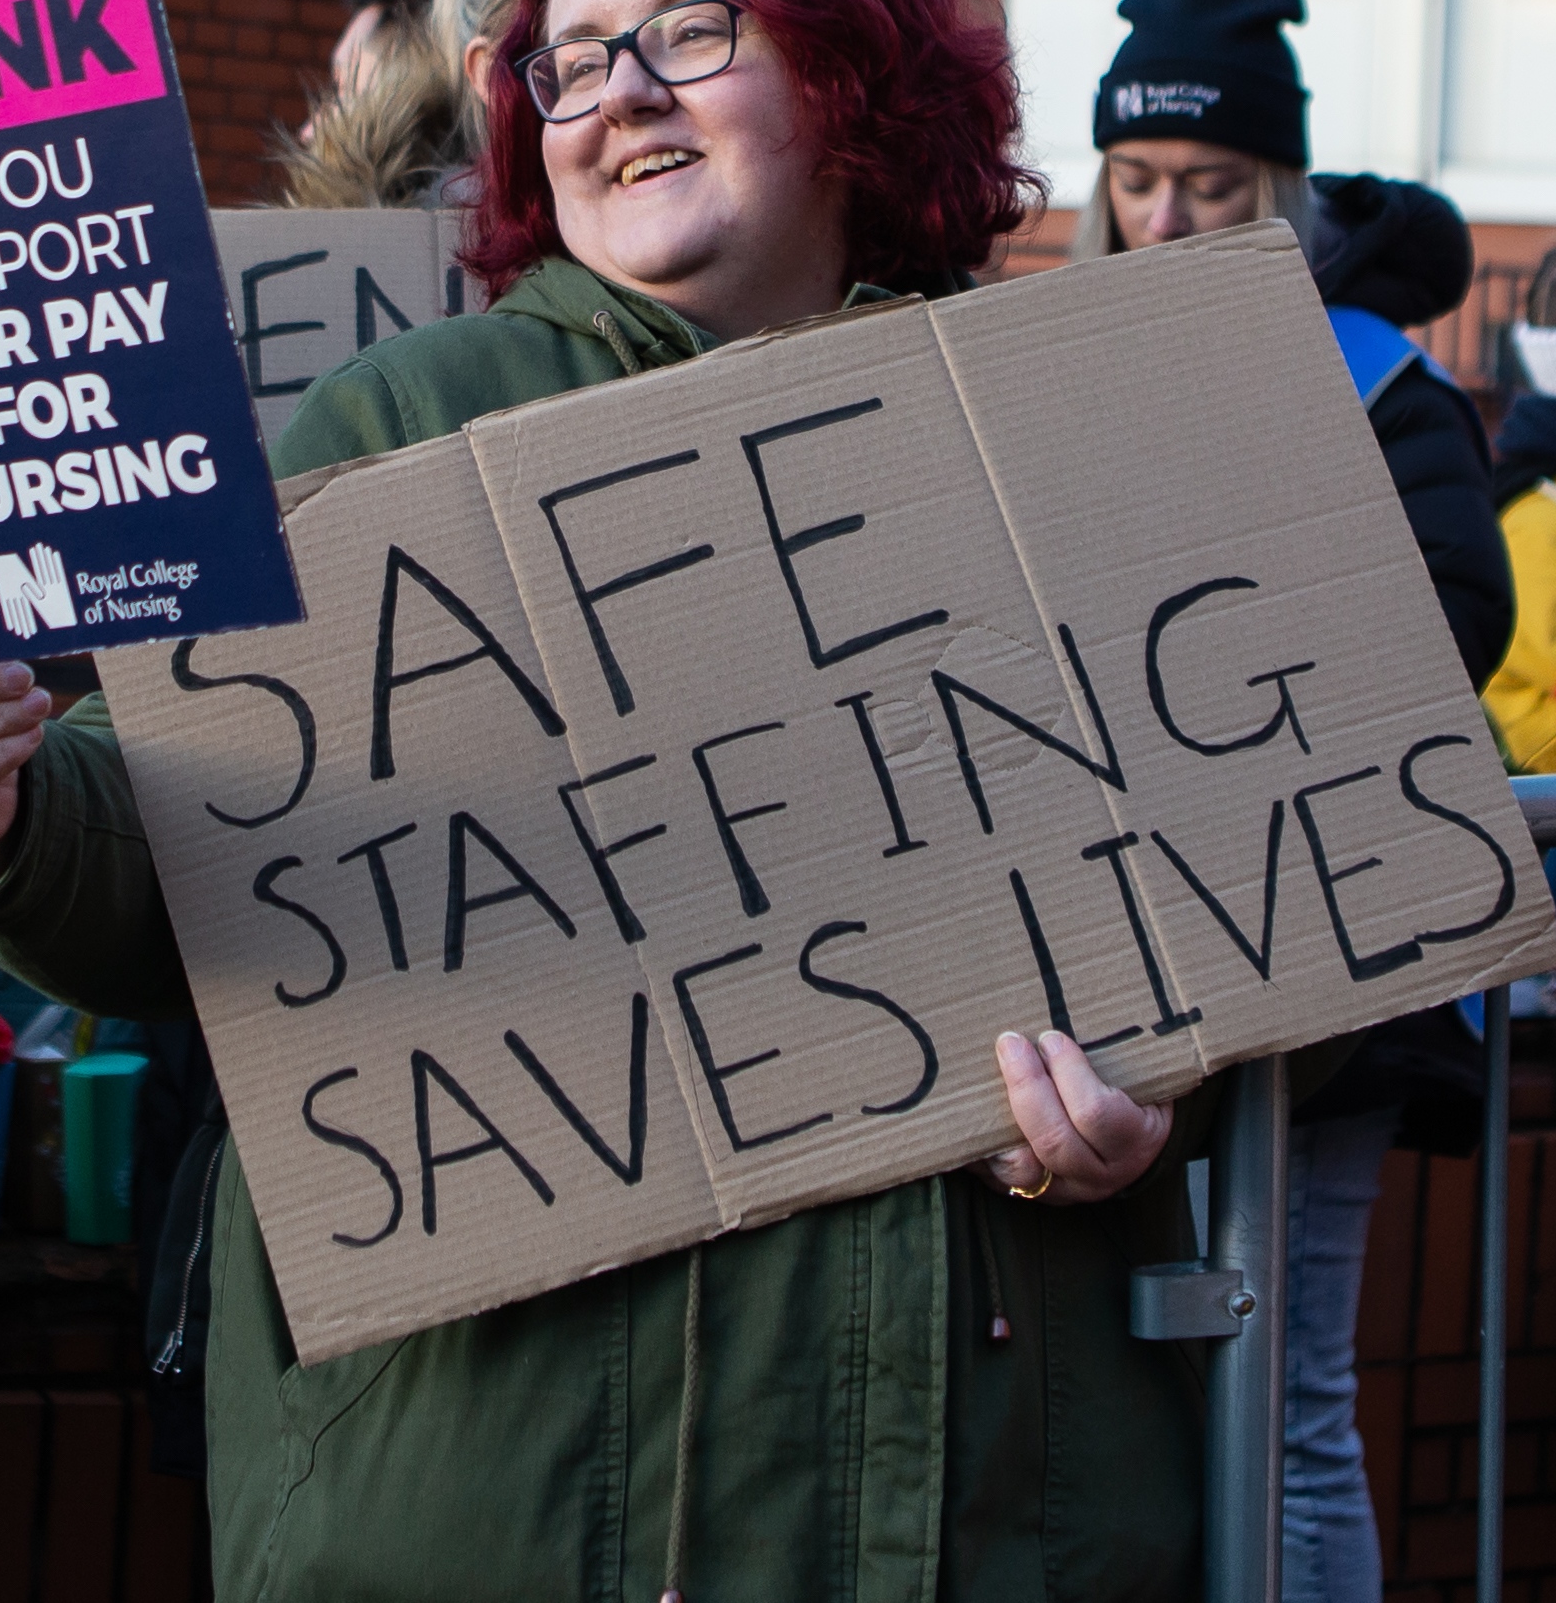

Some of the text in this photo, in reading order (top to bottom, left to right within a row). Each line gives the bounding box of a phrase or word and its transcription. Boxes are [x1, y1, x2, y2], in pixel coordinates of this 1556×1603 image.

[43, 280, 170, 361] PAY
[75, 559, 199, 601] Royal College
[84, 593, 182, 625] of Nursing
[172, 398, 949, 829] SAFE
[253, 576, 1316, 1008] STAFFING
[301, 735, 1516, 1249] SAVES LIVES
